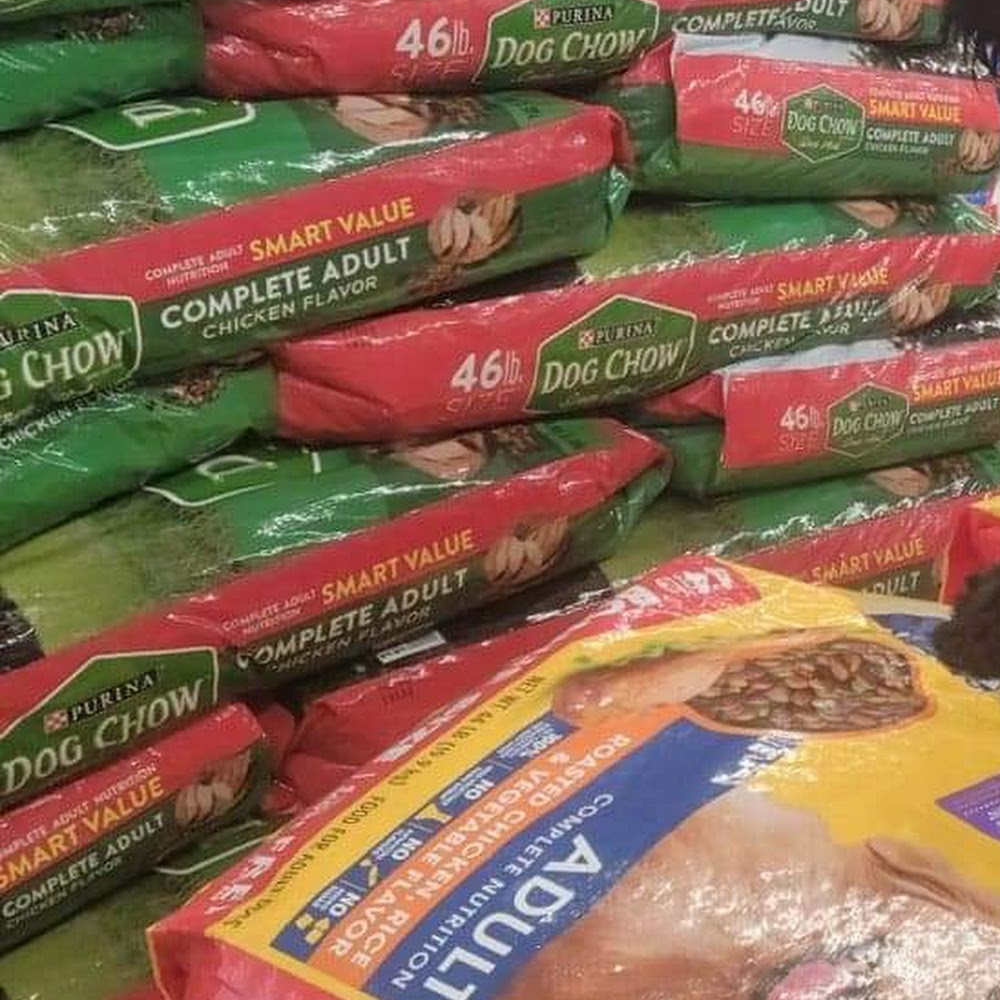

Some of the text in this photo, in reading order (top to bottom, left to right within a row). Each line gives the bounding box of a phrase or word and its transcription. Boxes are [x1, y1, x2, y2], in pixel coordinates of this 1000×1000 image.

[552, 6, 613, 25] PURINA
[492, 28, 646, 68] DOG CHOW
[731, 116, 775, 136] SIZE
[788, 111, 857, 136] DOG CHOW
[870, 100, 917, 121] SMART
[919, 102, 962, 123] VALUE
[867, 127, 955, 147] COMPLETE ADULT
[249, 197, 417, 262] SMART VALUE
[145, 245, 243, 282] COMPLETE ADULT
[166, 260, 229, 288] NUTRITION
[161, 237, 412, 330] COMPLETE ADULT
[777, 276, 835, 301] SMART
[202, 276, 379, 340] CHICKEN FLAVOR
[0, 313, 77, 347] URINA
[595, 320, 655, 345] PURINA
[708, 311, 811, 345] COMPLETE
[21, 329, 125, 389] CHOW
[541, 339, 682, 395] DOG CHOW
[911, 376, 961, 402] SMART
[833, 416, 862, 436] DOG
[863, 410, 904, 432] CHOW
[909, 406, 963, 426] COMPLETE
[964, 396, 1000, 414] ADULT
[321, 529, 475, 606] SMART VALUE
[811, 537, 926, 585] SMART VALUE
[862, 571, 920, 598] DULT
[235, 567, 469, 671] COMPLETE ADULT
[71, 674, 154, 722] PURINA
[1, 678, 205, 794] DOG CHOW
[530, 732, 632, 807] ROASTED
[464, 779, 495, 801] NO
[343, 794, 385, 825] FOOD
[422, 768, 548, 866] VEGETABLE
[0, 776, 164, 885] SMART VALUE
[0, 824, 48, 855] MPLETE
[318, 827, 346, 850] FOR
[2, 812, 166, 919] COMPLETE ADULT
[391, 838, 423, 861] NO
[329, 891, 361, 917] NO
[391, 792, 615, 990] COMPLETE NUTRITION
[330, 868, 424, 957] FLAVOR
[423, 833, 602, 1000] ADULT
[350, 909, 410, 967] RICE
